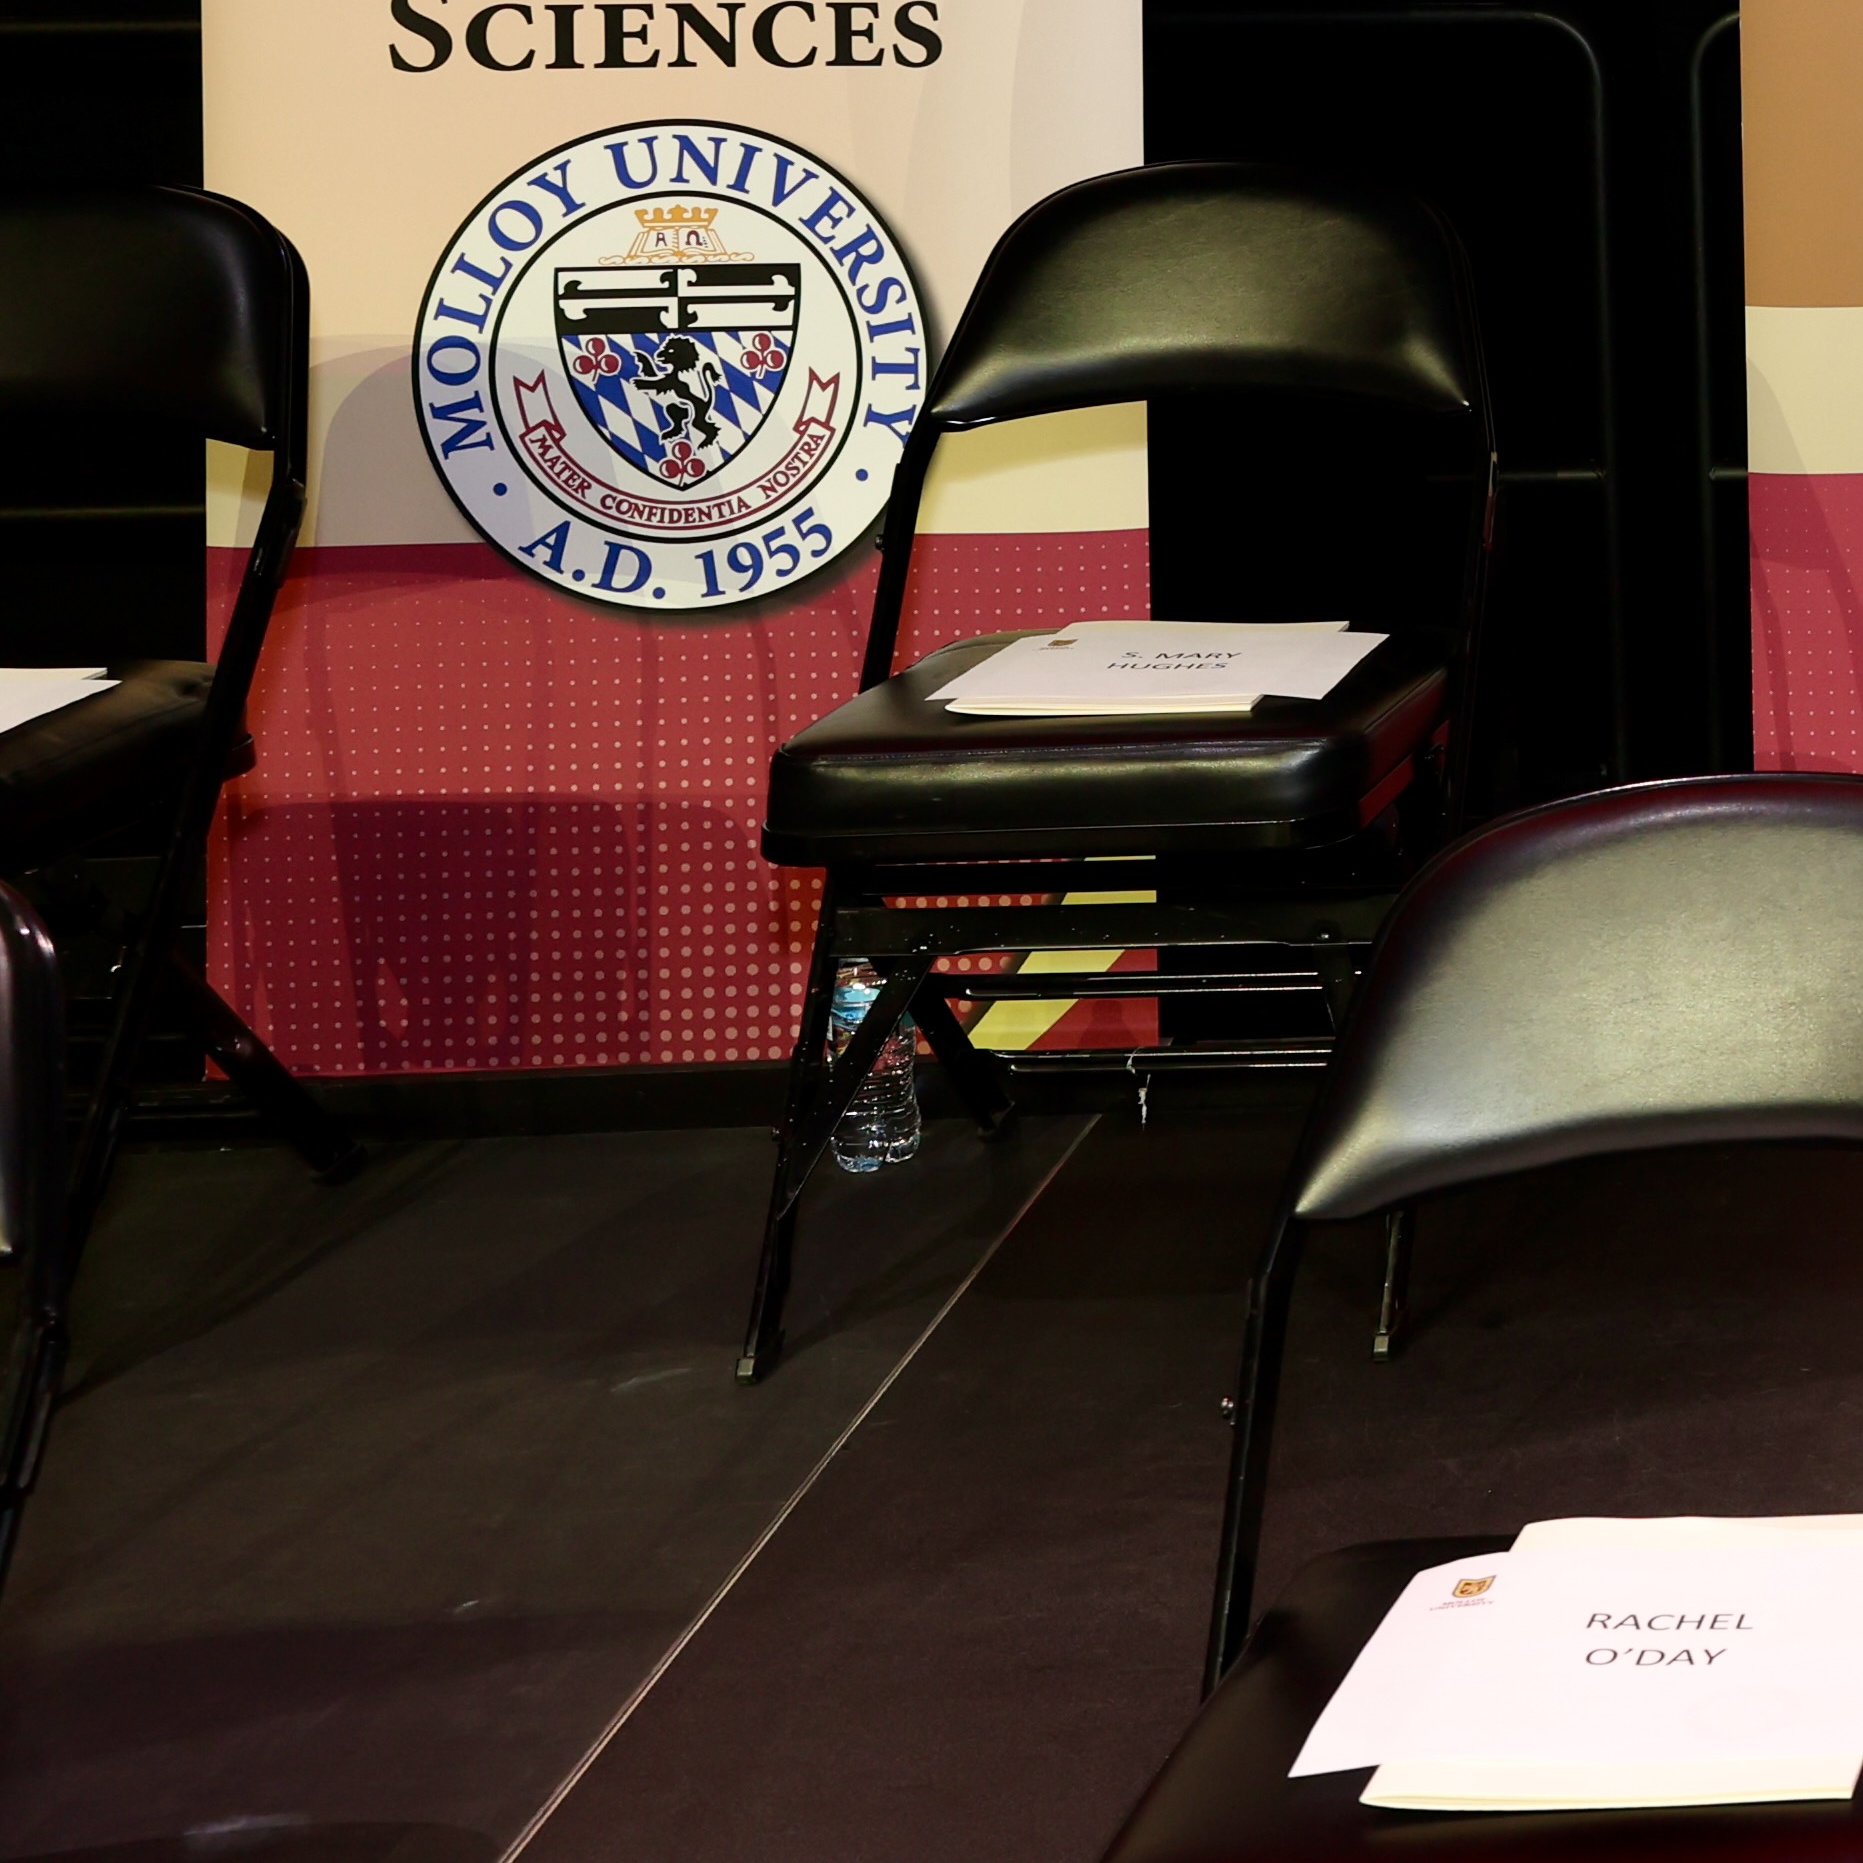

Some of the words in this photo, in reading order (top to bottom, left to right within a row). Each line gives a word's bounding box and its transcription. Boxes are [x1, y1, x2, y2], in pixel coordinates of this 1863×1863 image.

[427, 159, 586, 459] MOLLOY
[603, 134, 922, 450] UNIVERSITY
[531, 434, 590, 499] MATER
[600, 494, 751, 524] CONFIDENTIA
[757, 433, 824, 500] NOSTRA
[518, 519, 666, 600] A.D.
[694, 507, 834, 598] 1955
[1106, 662, 1229, 670] HUGHES
[1585, 1612, 1753, 1632] RACHEL
[1584, 1647, 1727, 1667] O'DAY
